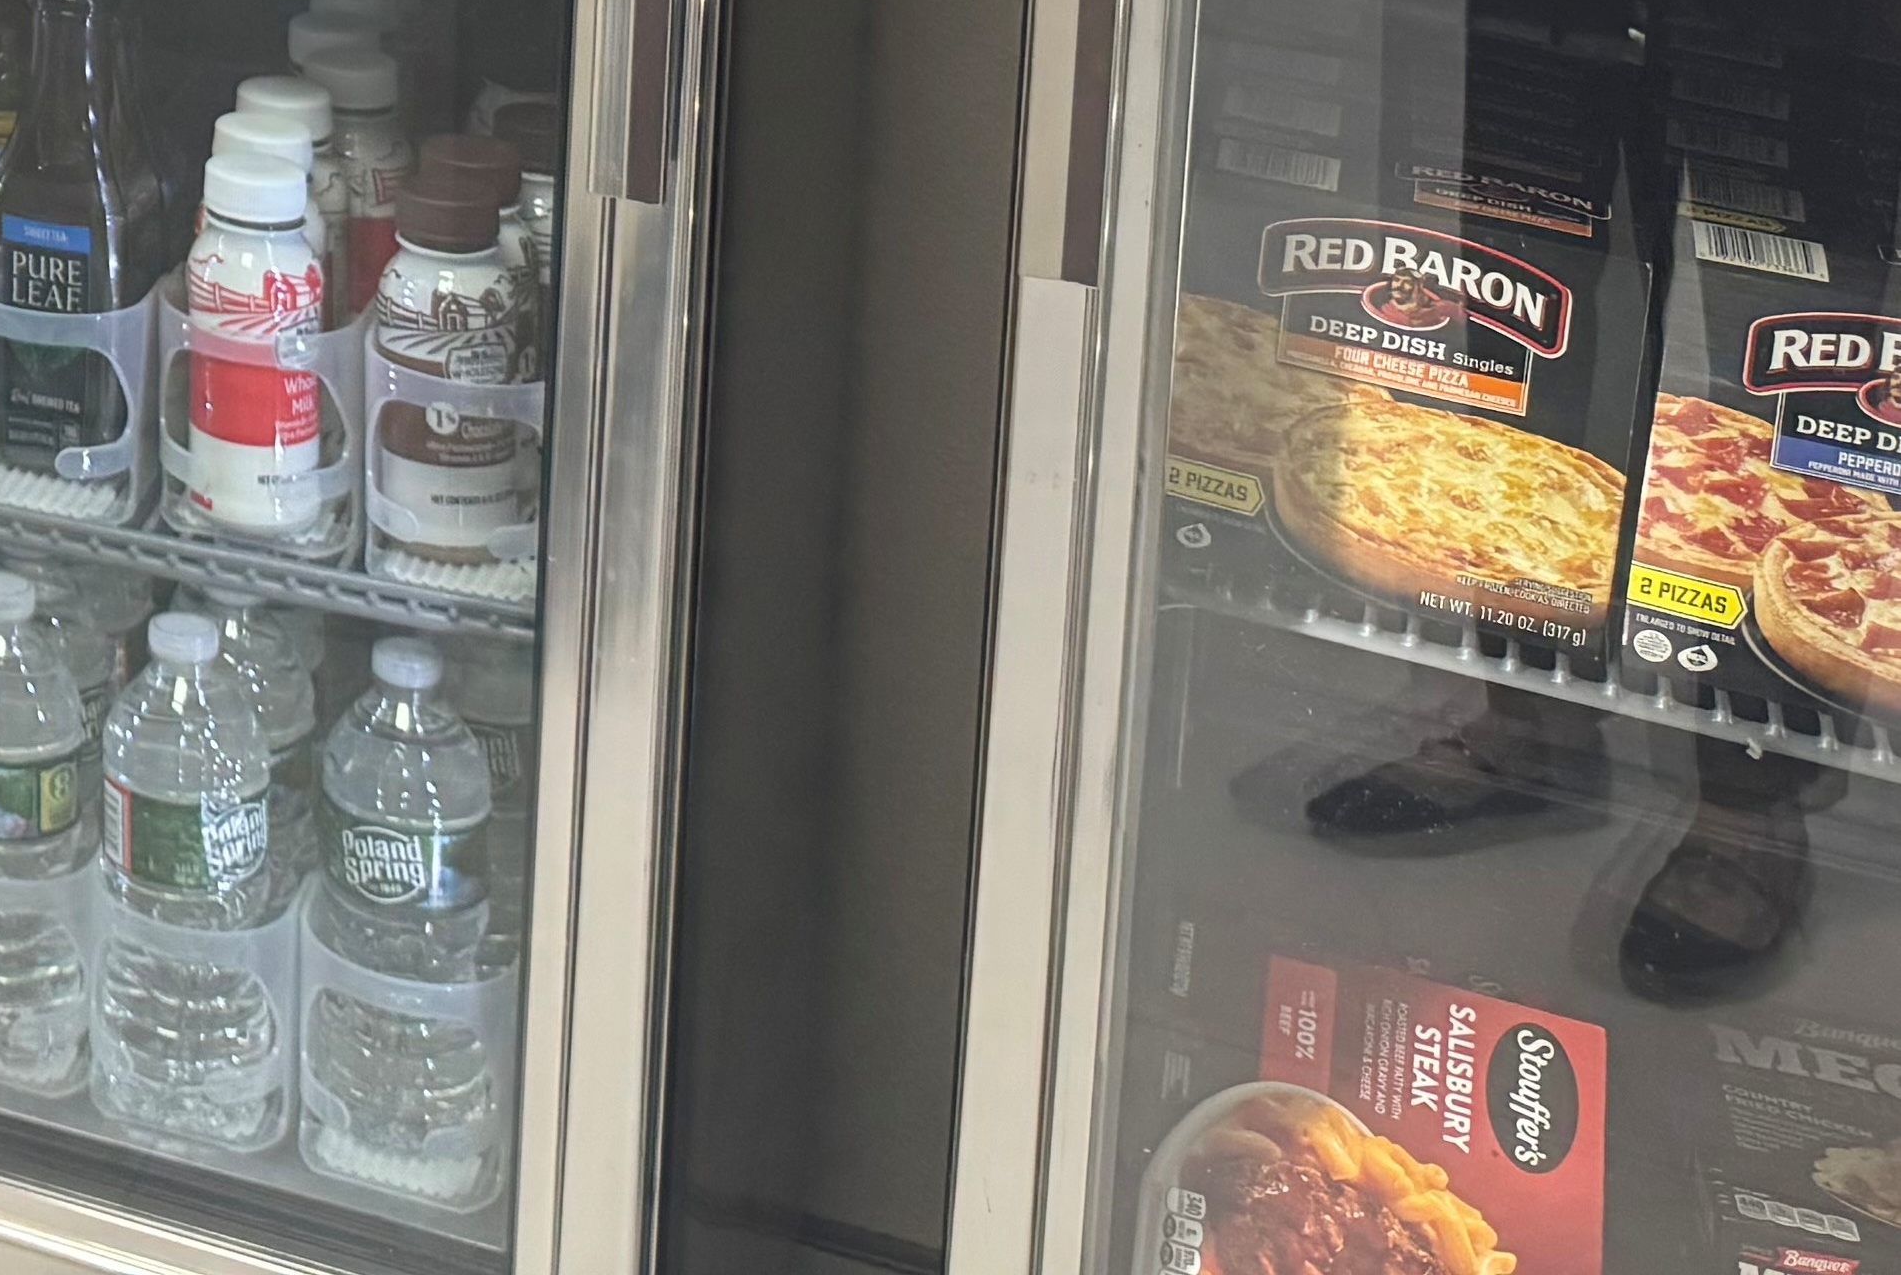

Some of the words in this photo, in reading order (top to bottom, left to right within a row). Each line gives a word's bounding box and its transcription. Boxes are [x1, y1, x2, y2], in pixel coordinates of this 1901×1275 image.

[12, 249, 82, 287] PURE
[1282, 232, 1374, 277] RED
[1383, 234, 1548, 331] BARON
[12, 277, 82, 313] LEAF
[1308, 314, 1379, 346] DEEP
[1382, 329, 1447, 362] DISH
[1451, 350, 1515, 377] Singles
[1335, 344, 1368, 367] FOUR
[1371, 351, 1427, 381] CHEESE
[1429, 366, 1469, 389] PIZZA
[1418, 589, 1443, 610] NET
[1448, 595, 1475, 618] WT.
[1478, 602, 1514, 626] 11.20
[1517, 611, 1538, 632] OZ.
[1639, 576, 1654, 595] 2
[1657, 579, 1728, 616] PIZZAS
[342, 829, 422, 869] Poland
[344, 856, 426, 891] Spring
[1409, 1024, 1441, 1110] STEAK
[1443, 1002, 1477, 1155] SALISBURY
[1509, 1027, 1556, 1167] Stouffer's
